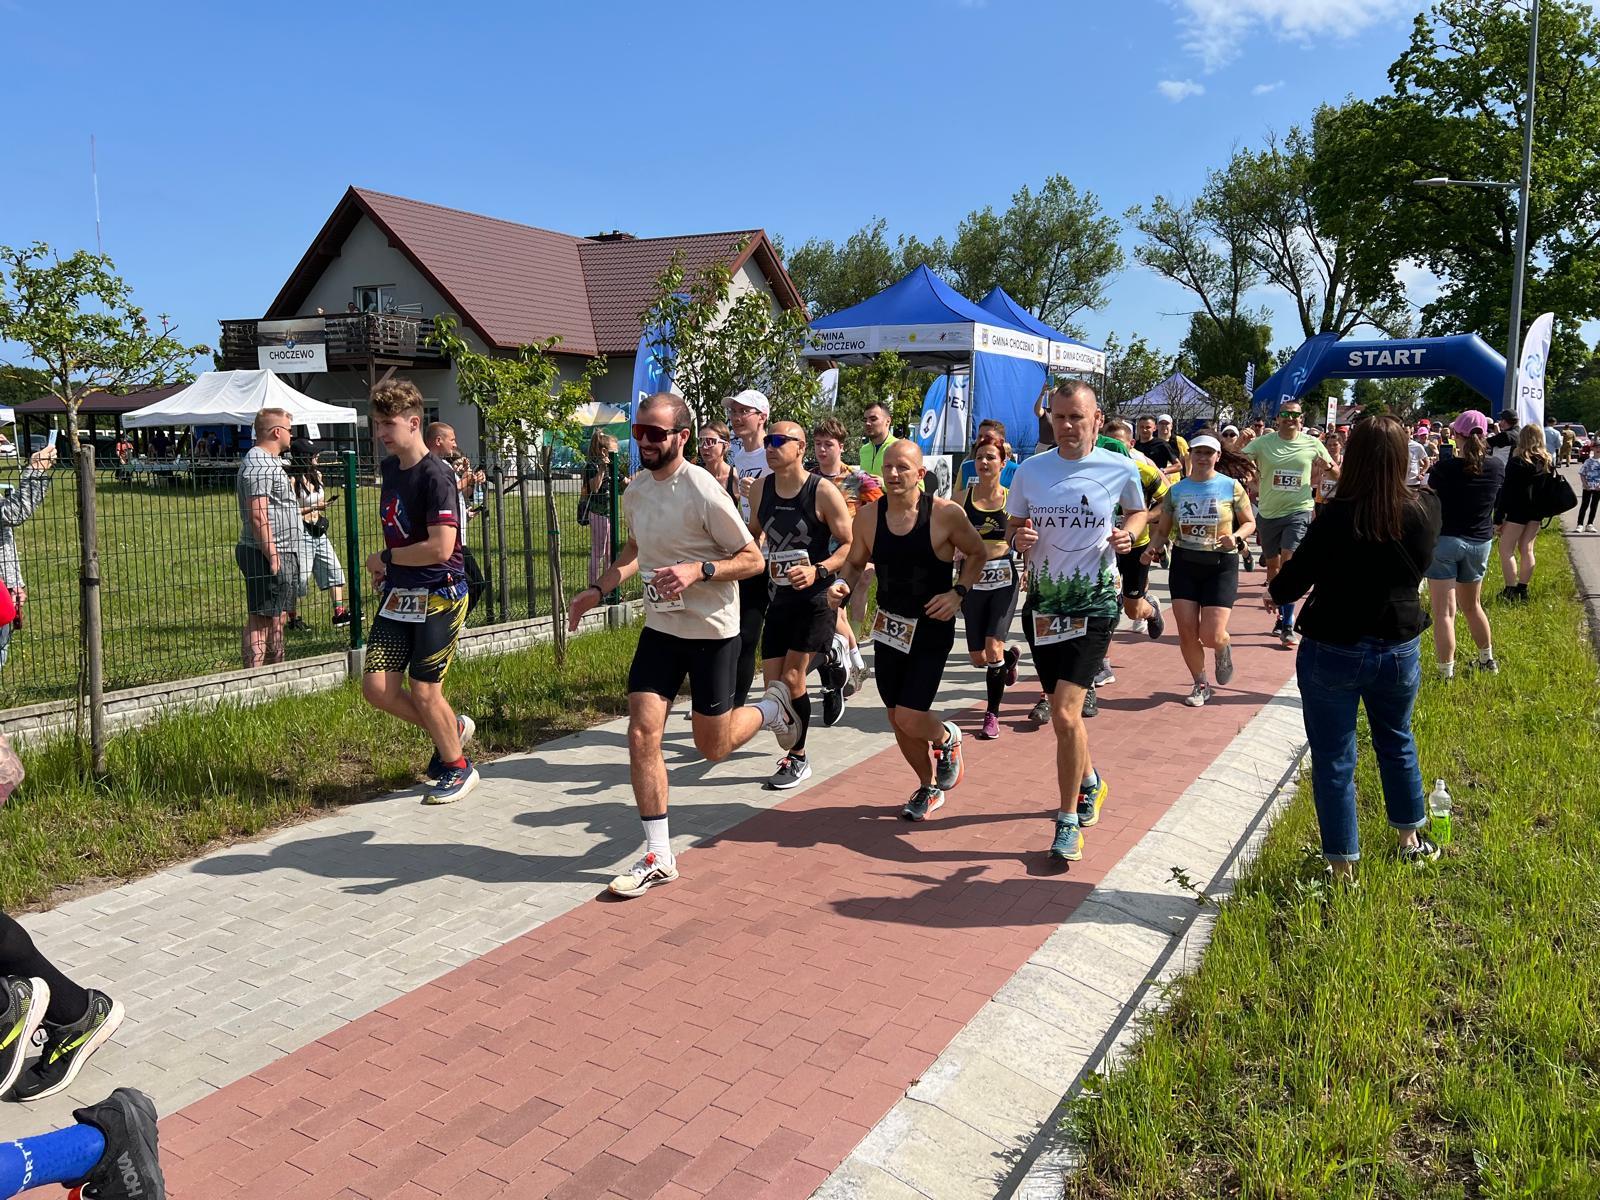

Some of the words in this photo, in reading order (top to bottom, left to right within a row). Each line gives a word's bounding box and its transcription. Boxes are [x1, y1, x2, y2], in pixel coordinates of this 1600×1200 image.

[992, 335, 1009, 347] GMINA
[1010, 338, 1035, 353] CHOCZEWO
[269, 349, 315, 360] CHOCZEWO
[1348, 348, 1427, 367] START
[1521, 386, 1543, 400] PEJ
[1277, 476, 1298, 486] 158
[1029, 504, 1079, 515] Pomorska
[1032, 516, 1105, 529] WATAHA
[1191, 525, 1206, 537] 66
[980, 568, 1006, 583] 228
[394, 596, 420, 612] 121
[881, 617, 908, 640] 132
[1050, 616, 1073, 633] 41
[117, 1150, 143, 1197] HOKA
